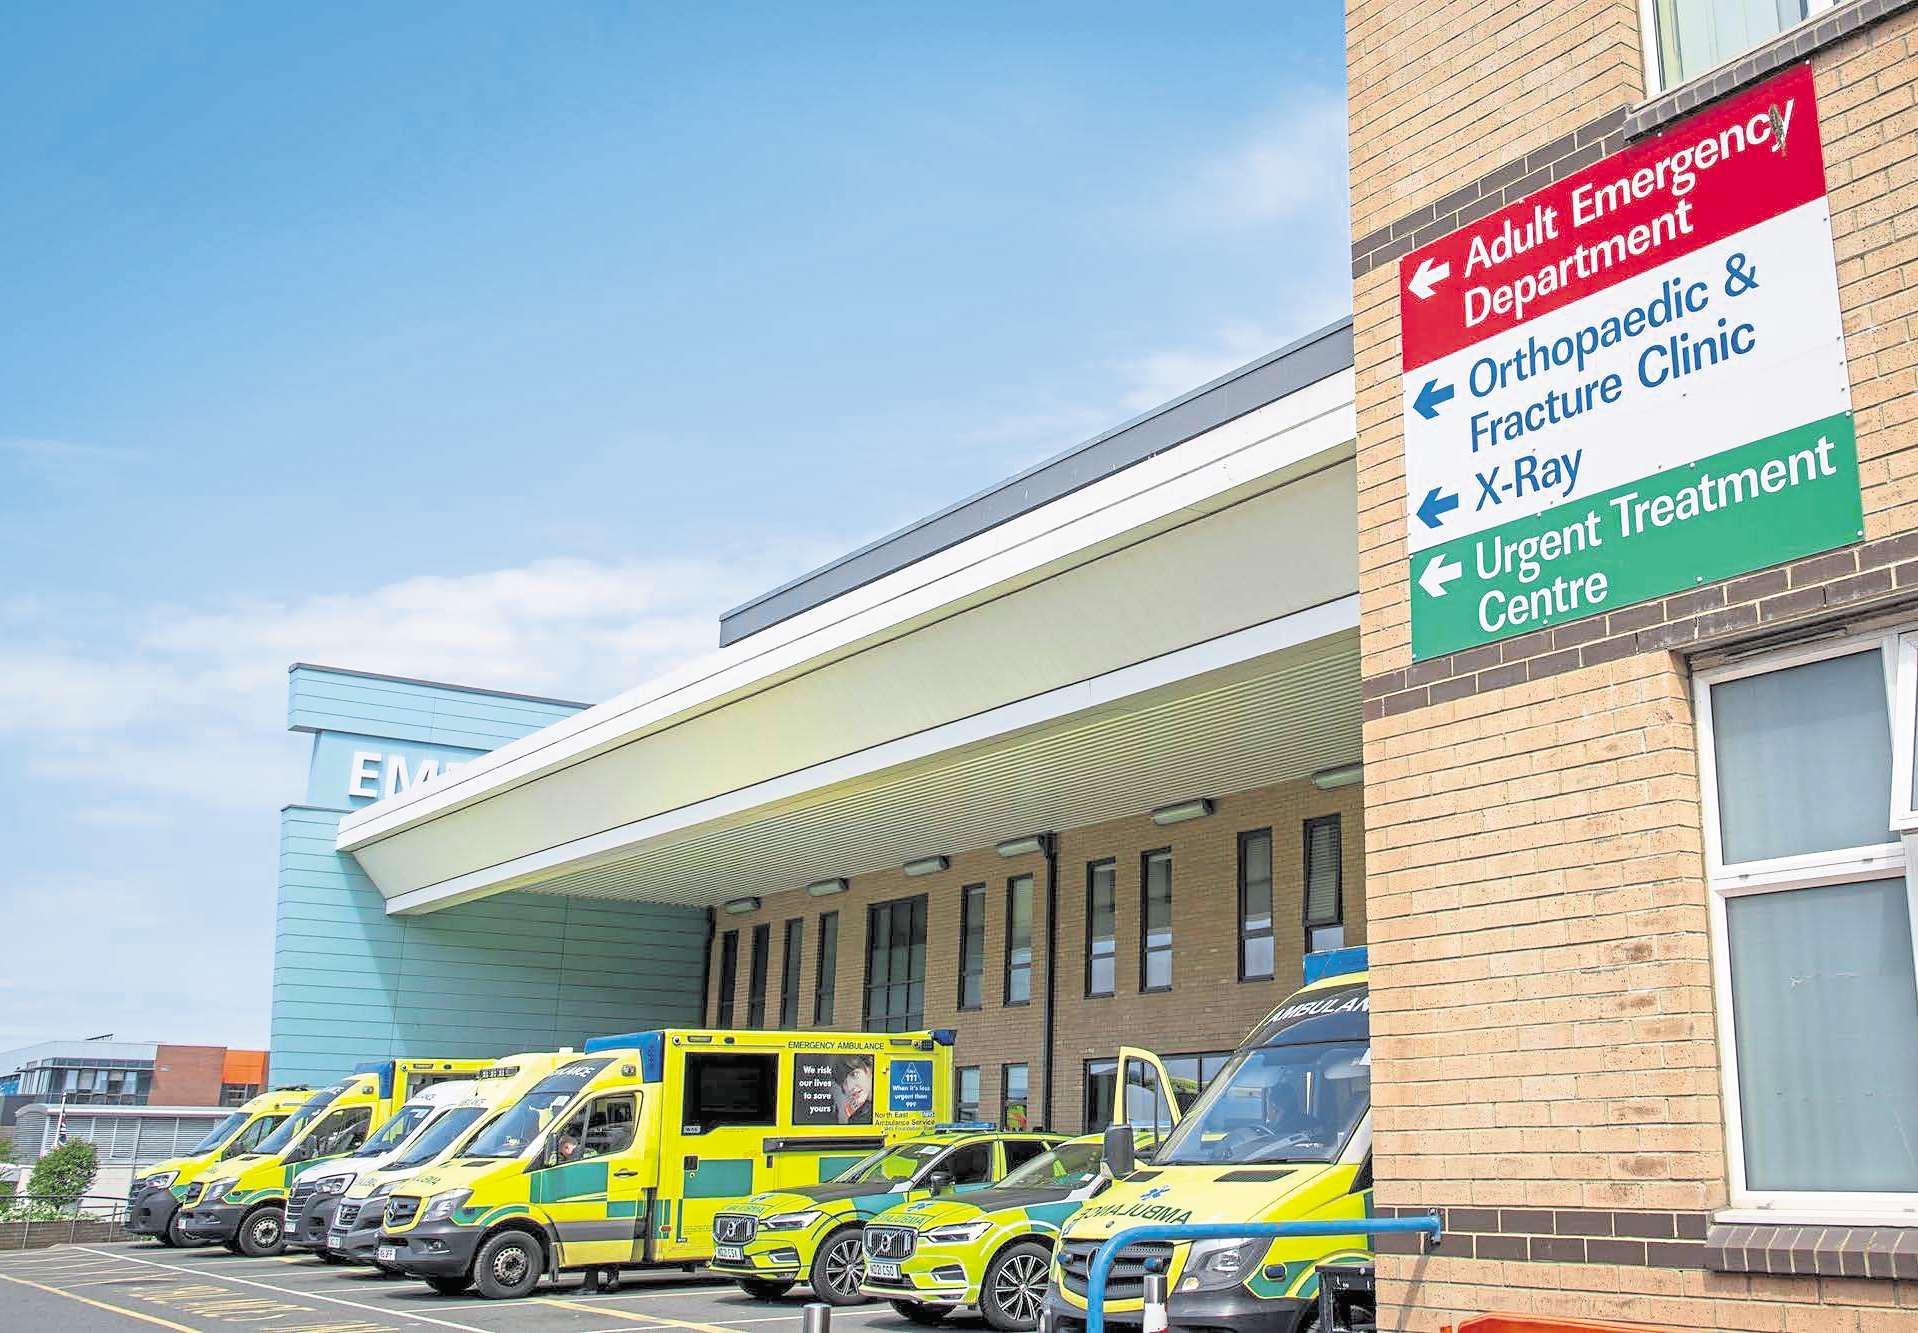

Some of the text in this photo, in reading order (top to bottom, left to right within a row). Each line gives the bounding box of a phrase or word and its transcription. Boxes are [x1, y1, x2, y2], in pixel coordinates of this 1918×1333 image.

[1463, 98, 1795, 278] Adult Emergency
[1463, 199, 1694, 329] Department
[1469, 252, 1761, 398] Orthopaedic &
[1470, 317, 1756, 452] Fracture Clinic
[1474, 448, 1583, 512] X-Ray
[1475, 436, 1837, 584] Urgent Treatment
[1478, 572, 1608, 633] Centre
[788, 1041, 885, 1050] EMERGENCY AMBULANCE
[803, 1065, 832, 1074] We risk
[814, 1079, 832, 1087] lives
[905, 1073, 918, 1082] 111
[803, 1092, 812, 1100] to
[809, 1106, 832, 1115] yours
[911, 1118, 936, 1126] Service
